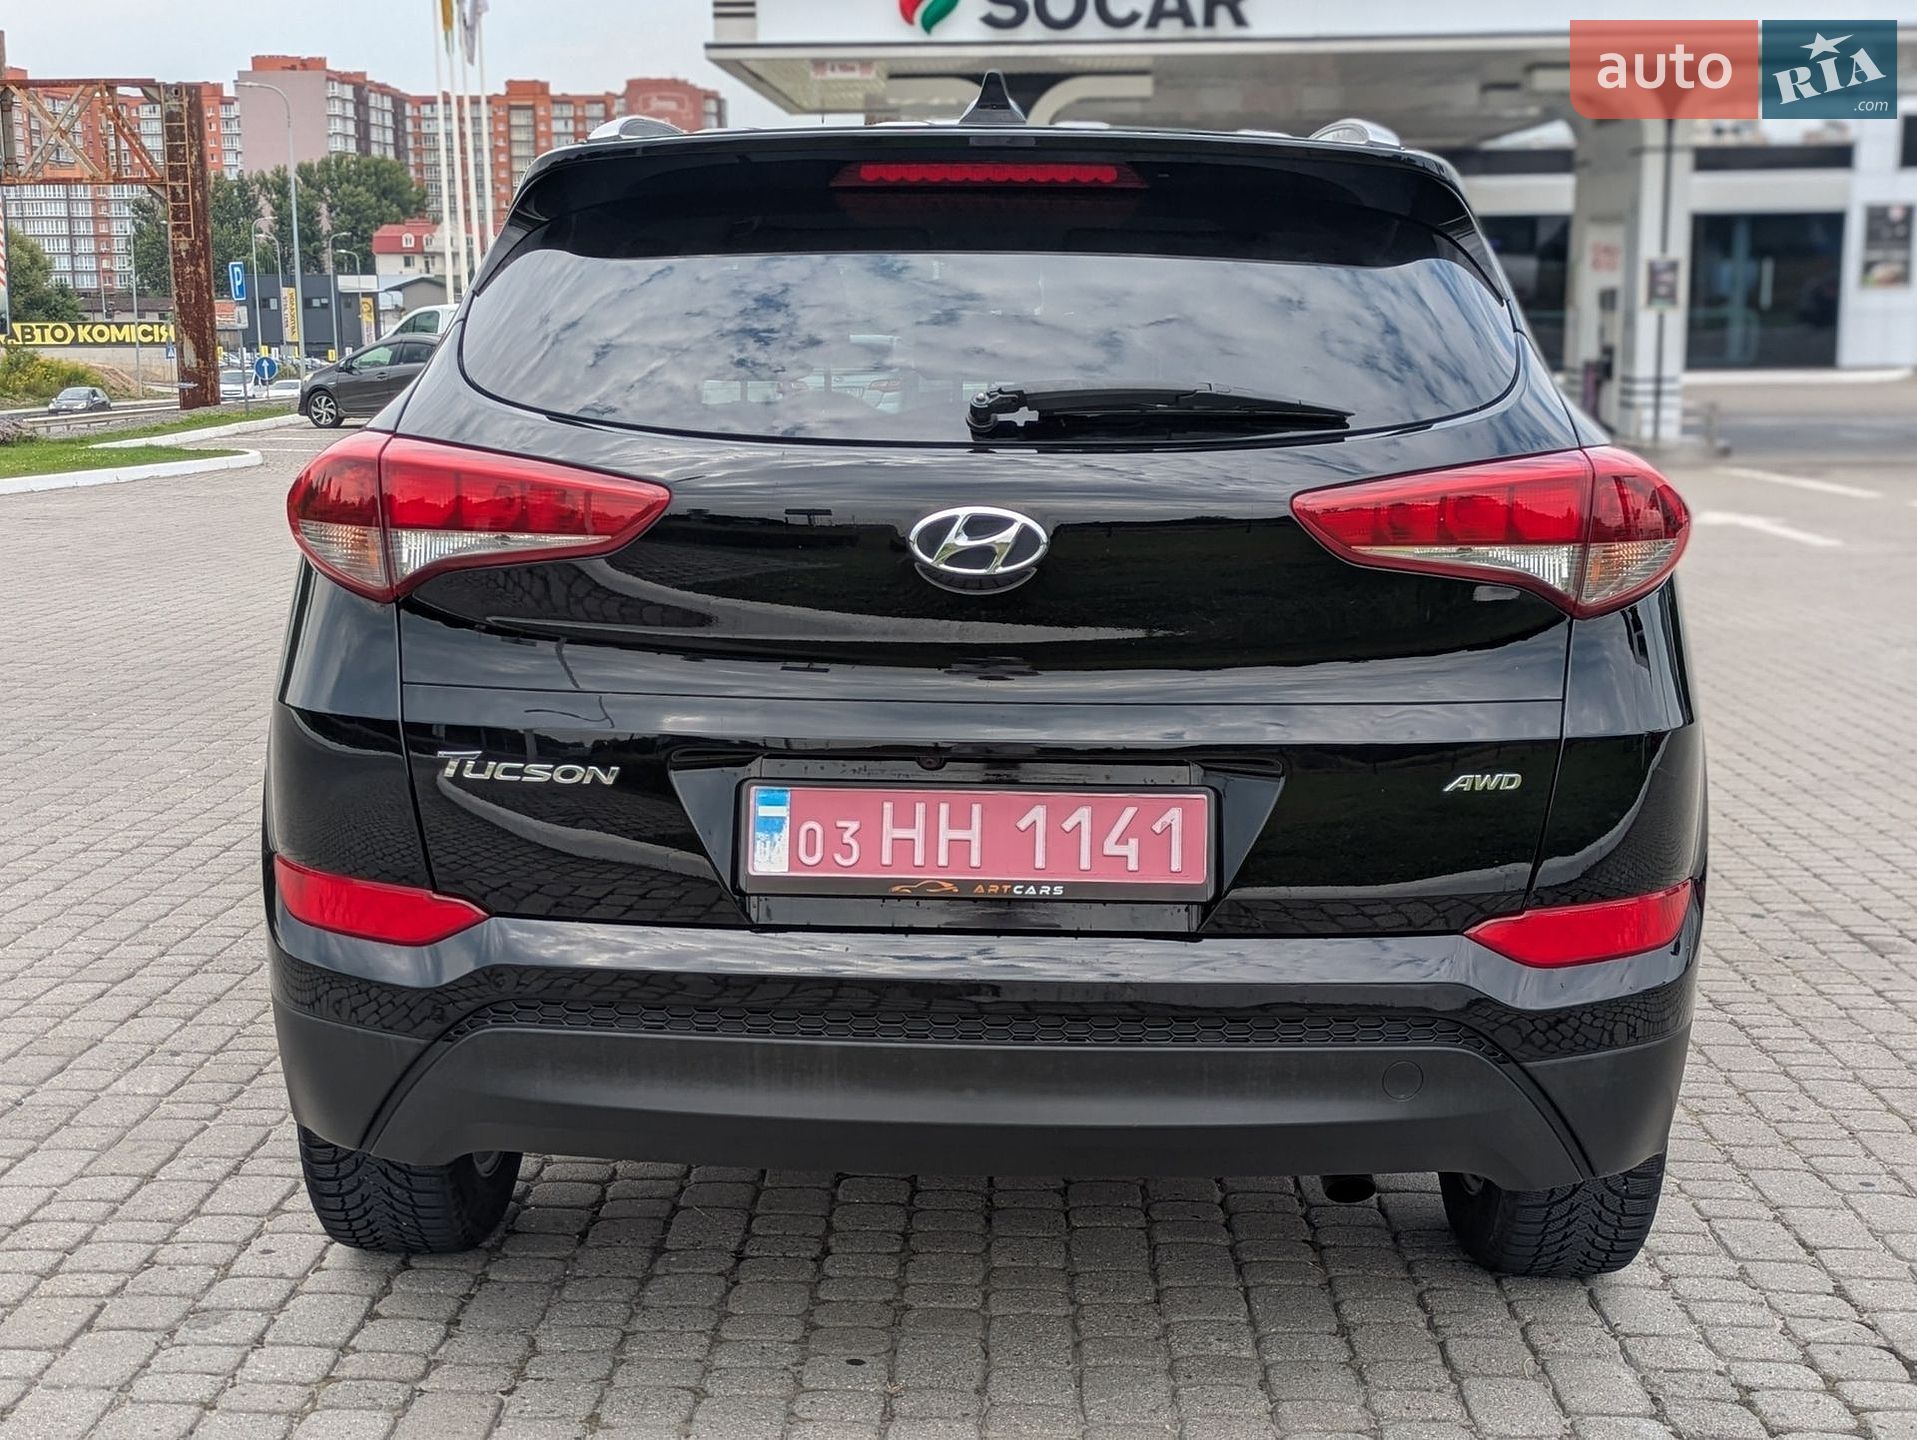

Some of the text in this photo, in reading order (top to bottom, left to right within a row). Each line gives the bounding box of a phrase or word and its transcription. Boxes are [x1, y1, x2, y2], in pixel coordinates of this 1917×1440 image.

[979, 0, 1250, 30] SOCAR
[233, 266, 242, 296] P
[1442, 773, 1523, 792] AWD
[798, 820, 861, 867] 03
[881, 801, 981, 868] HH
[1015, 804, 1183, 872] 1141
[973, 884, 1064, 895] ARTCARS
